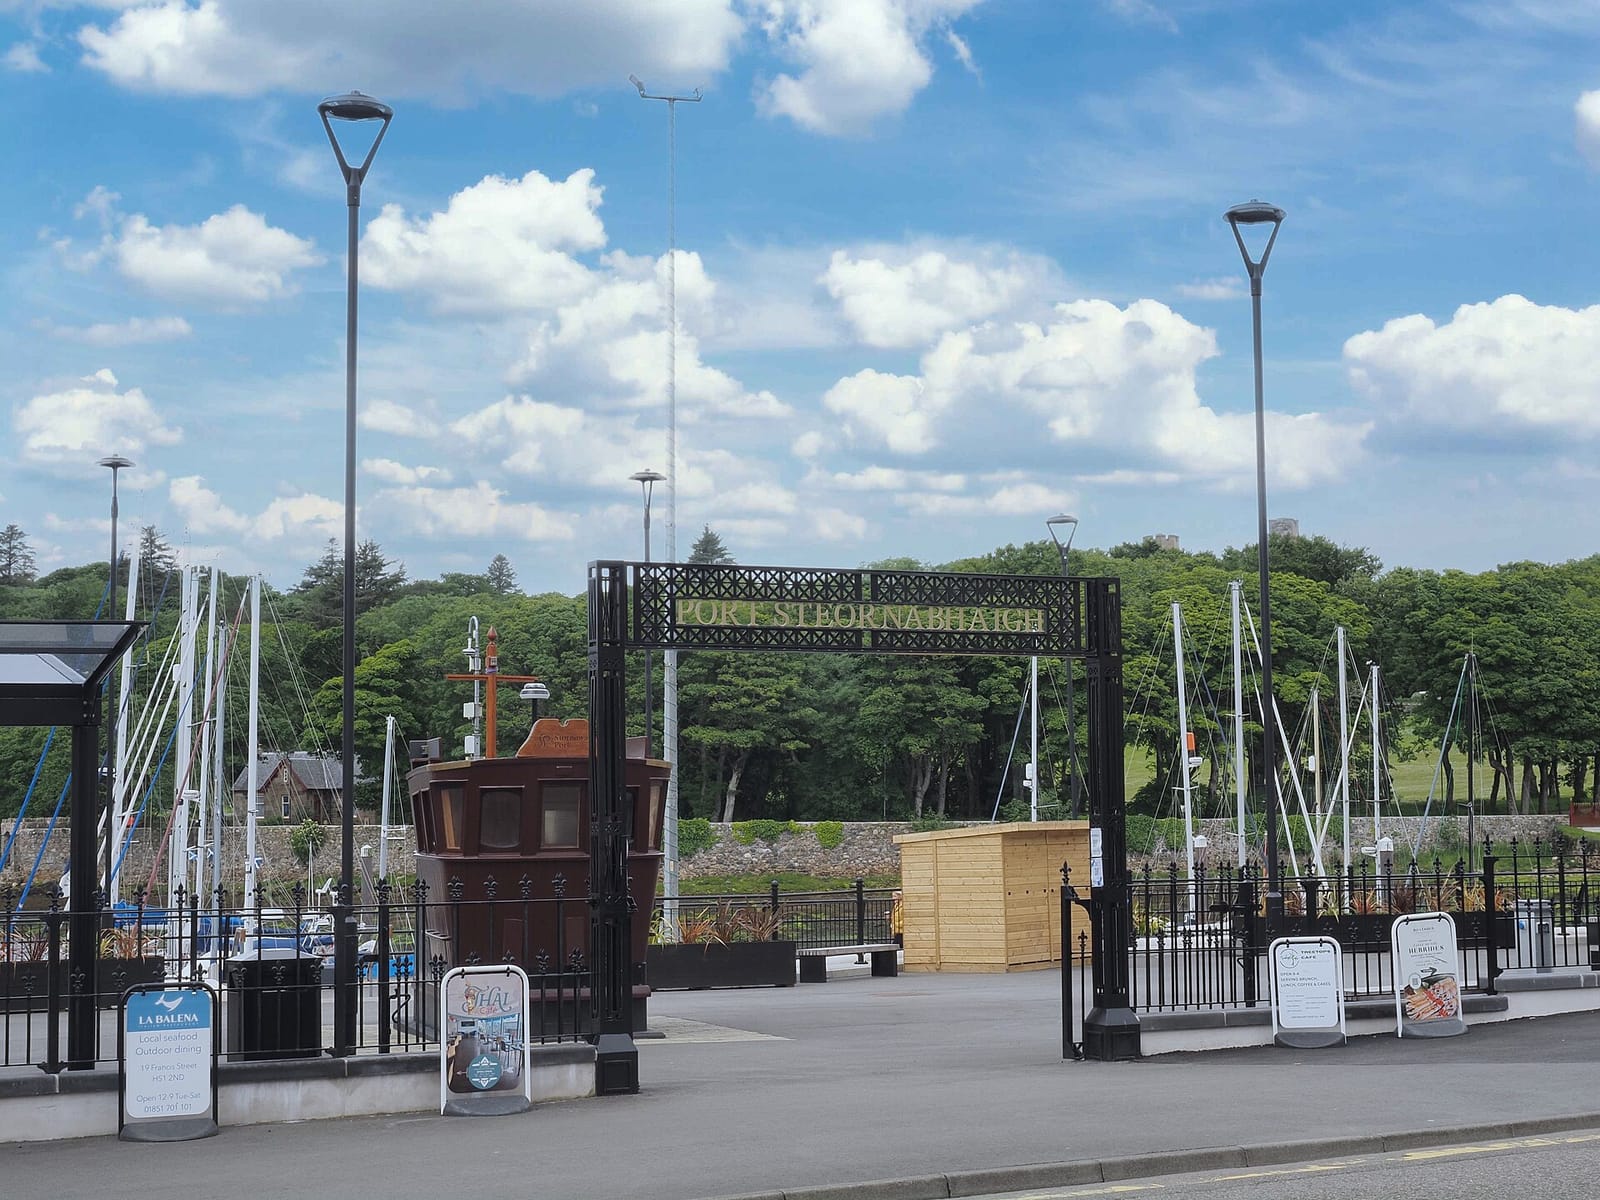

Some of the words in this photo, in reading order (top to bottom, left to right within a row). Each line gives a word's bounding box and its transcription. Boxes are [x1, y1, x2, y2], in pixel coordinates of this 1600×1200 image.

[676, 599, 760, 626] PORT
[773, 602, 1045, 633] STEORNABHAIGH
[462, 984, 512, 1013] THAI
[139, 1015, 153, 1025] LA
[155, 1014, 199, 1023] BALENA
[139, 1034, 162, 1043] Local
[163, 1031, 198, 1042] seafood
[135, 1046, 172, 1056] Outdoor
[174, 1045, 202, 1055] dining
[141, 1064, 150, 1072] 19
[176, 1062, 198, 1070] Street
[168, 1073, 185, 1081] 2ND
[136, 1094, 157, 1104] Open
